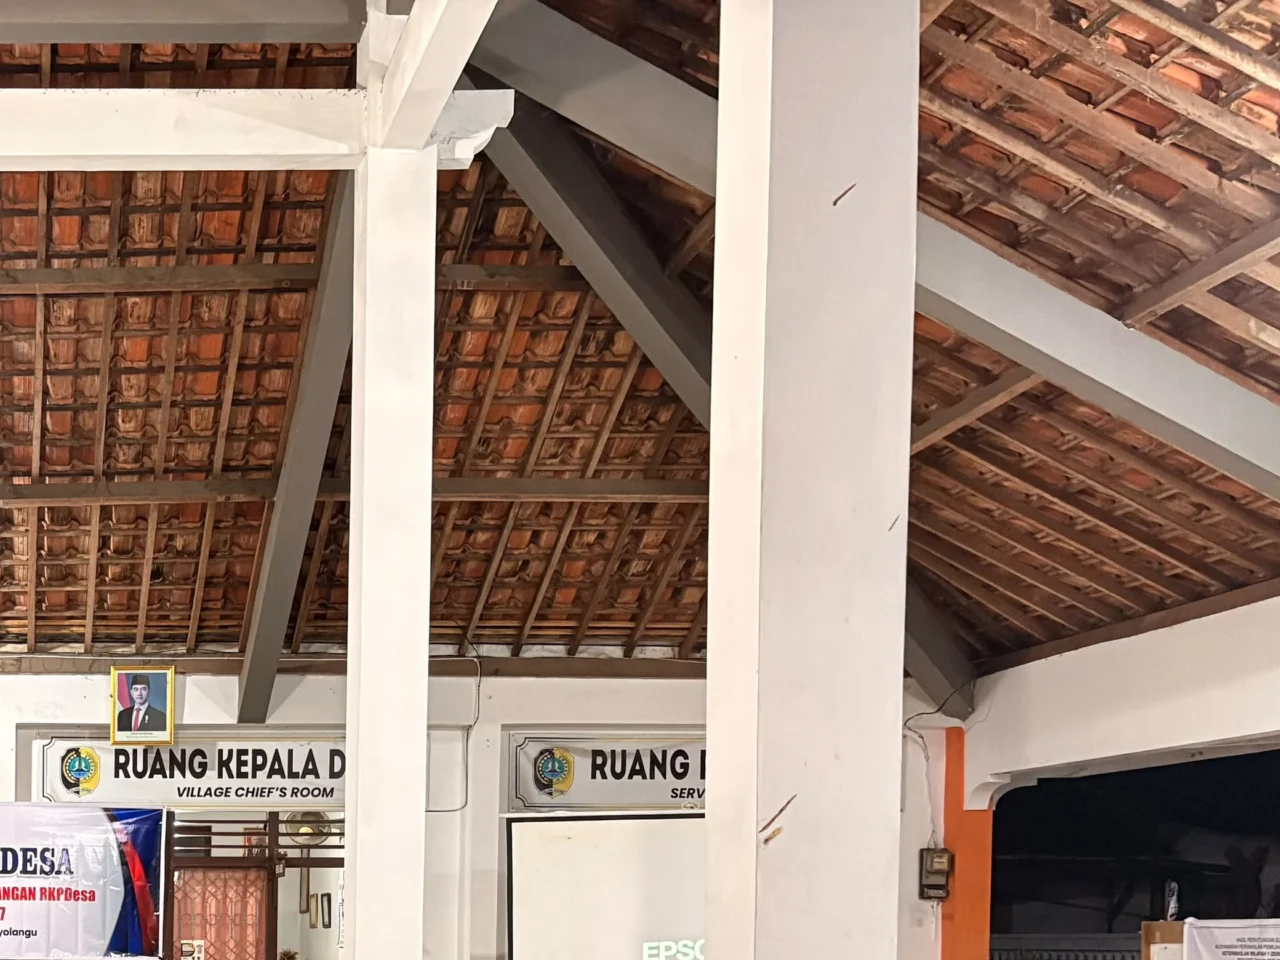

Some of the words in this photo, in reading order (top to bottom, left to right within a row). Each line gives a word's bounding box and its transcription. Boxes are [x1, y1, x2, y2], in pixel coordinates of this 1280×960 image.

[114, 748, 208, 780] RUANG
[218, 748, 320, 780] KEPALA
[590, 749, 690, 780] RUANG
[177, 786, 232, 798] VILLAGE
[235, 786, 287, 798] CHIEF'S
[290, 786, 334, 798] ROOM
[0, 847, 74, 876] DESA
[39, 887, 96, 902] RKPDesa
